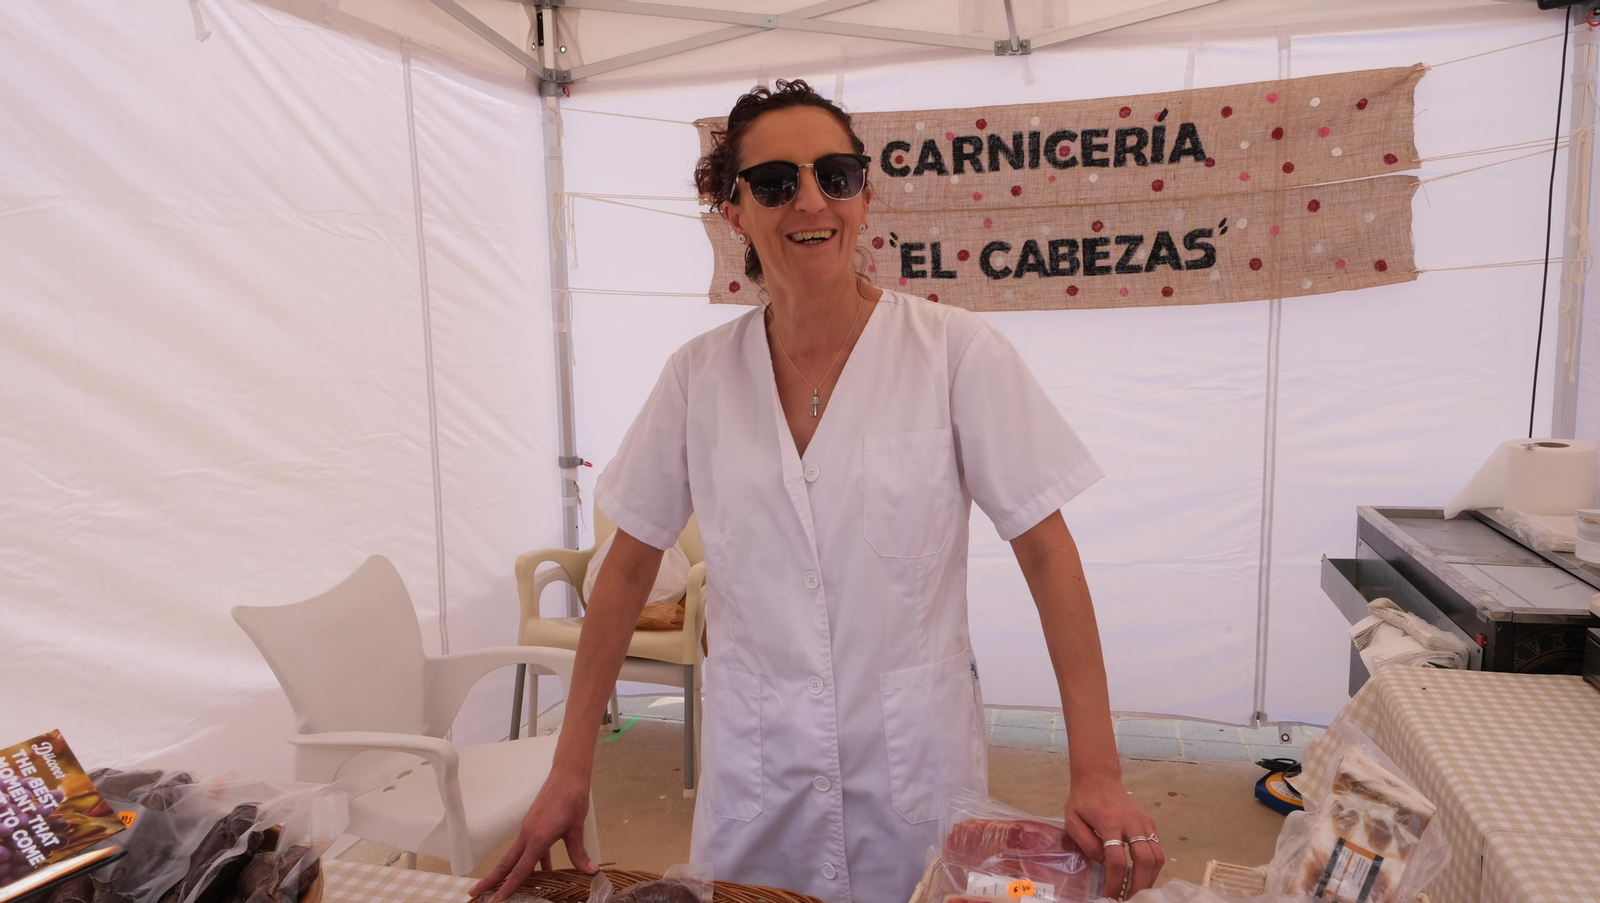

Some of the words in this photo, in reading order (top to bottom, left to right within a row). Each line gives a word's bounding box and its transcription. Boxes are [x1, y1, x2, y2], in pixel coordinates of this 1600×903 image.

[880, 108, 1207, 177] CARNICERÍA
[11, 748, 38, 777] THE
[28, 777, 59, 810] BEST
[31, 742, 66, 779] Discover
[0, 807, 20, 828] TO
[12, 829, 46, 866] COME
[28, 814, 60, 847] THAT
